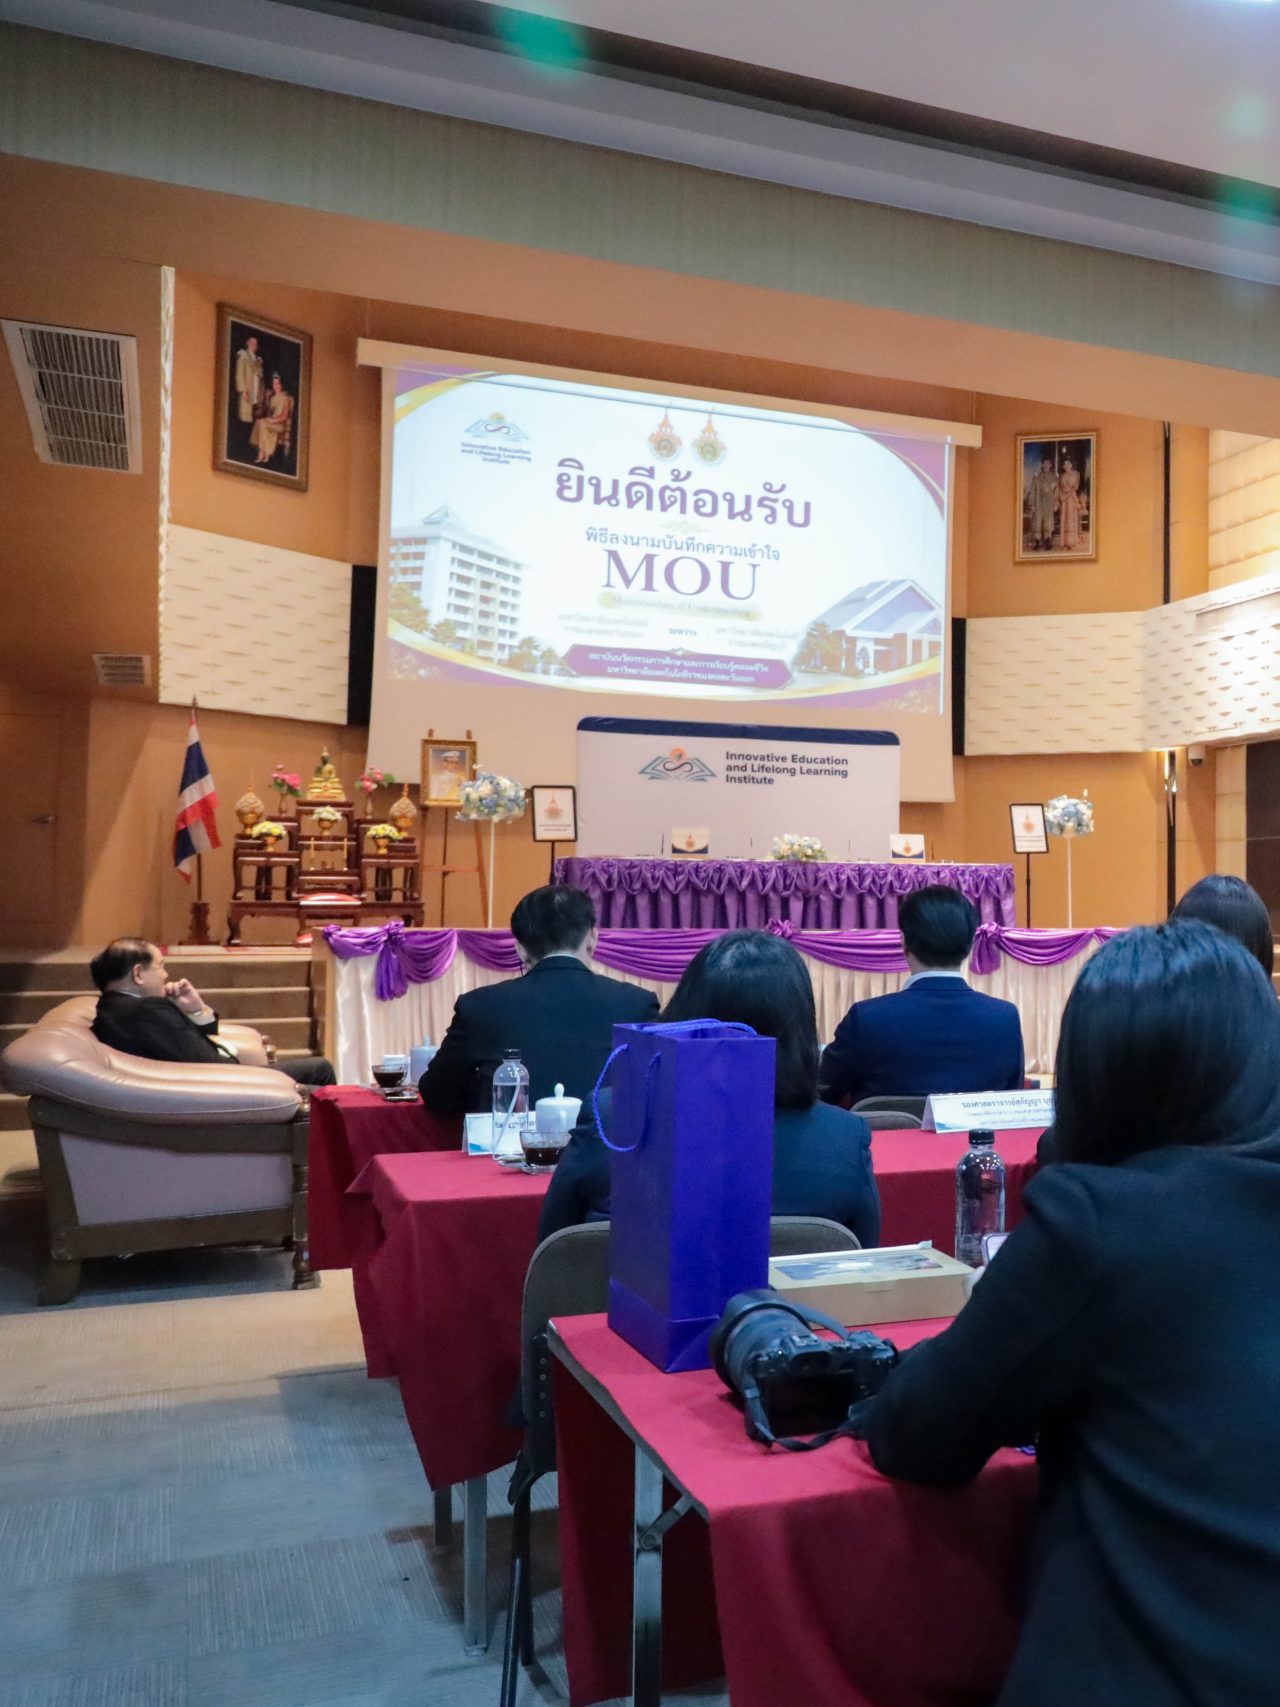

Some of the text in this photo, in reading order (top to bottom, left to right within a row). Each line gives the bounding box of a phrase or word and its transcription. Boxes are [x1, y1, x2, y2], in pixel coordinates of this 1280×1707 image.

[555, 457, 812, 528] ยินดีต้อนรับ
[585, 526, 780, 561] พิธีลงนามบันทึกความเข้าใจ
[601, 549, 761, 601] MOU
[726, 751, 848, 766] Innovative Education
[726, 763, 849, 779] and Lifelong Learning
[726, 774, 775, 785] Institute
